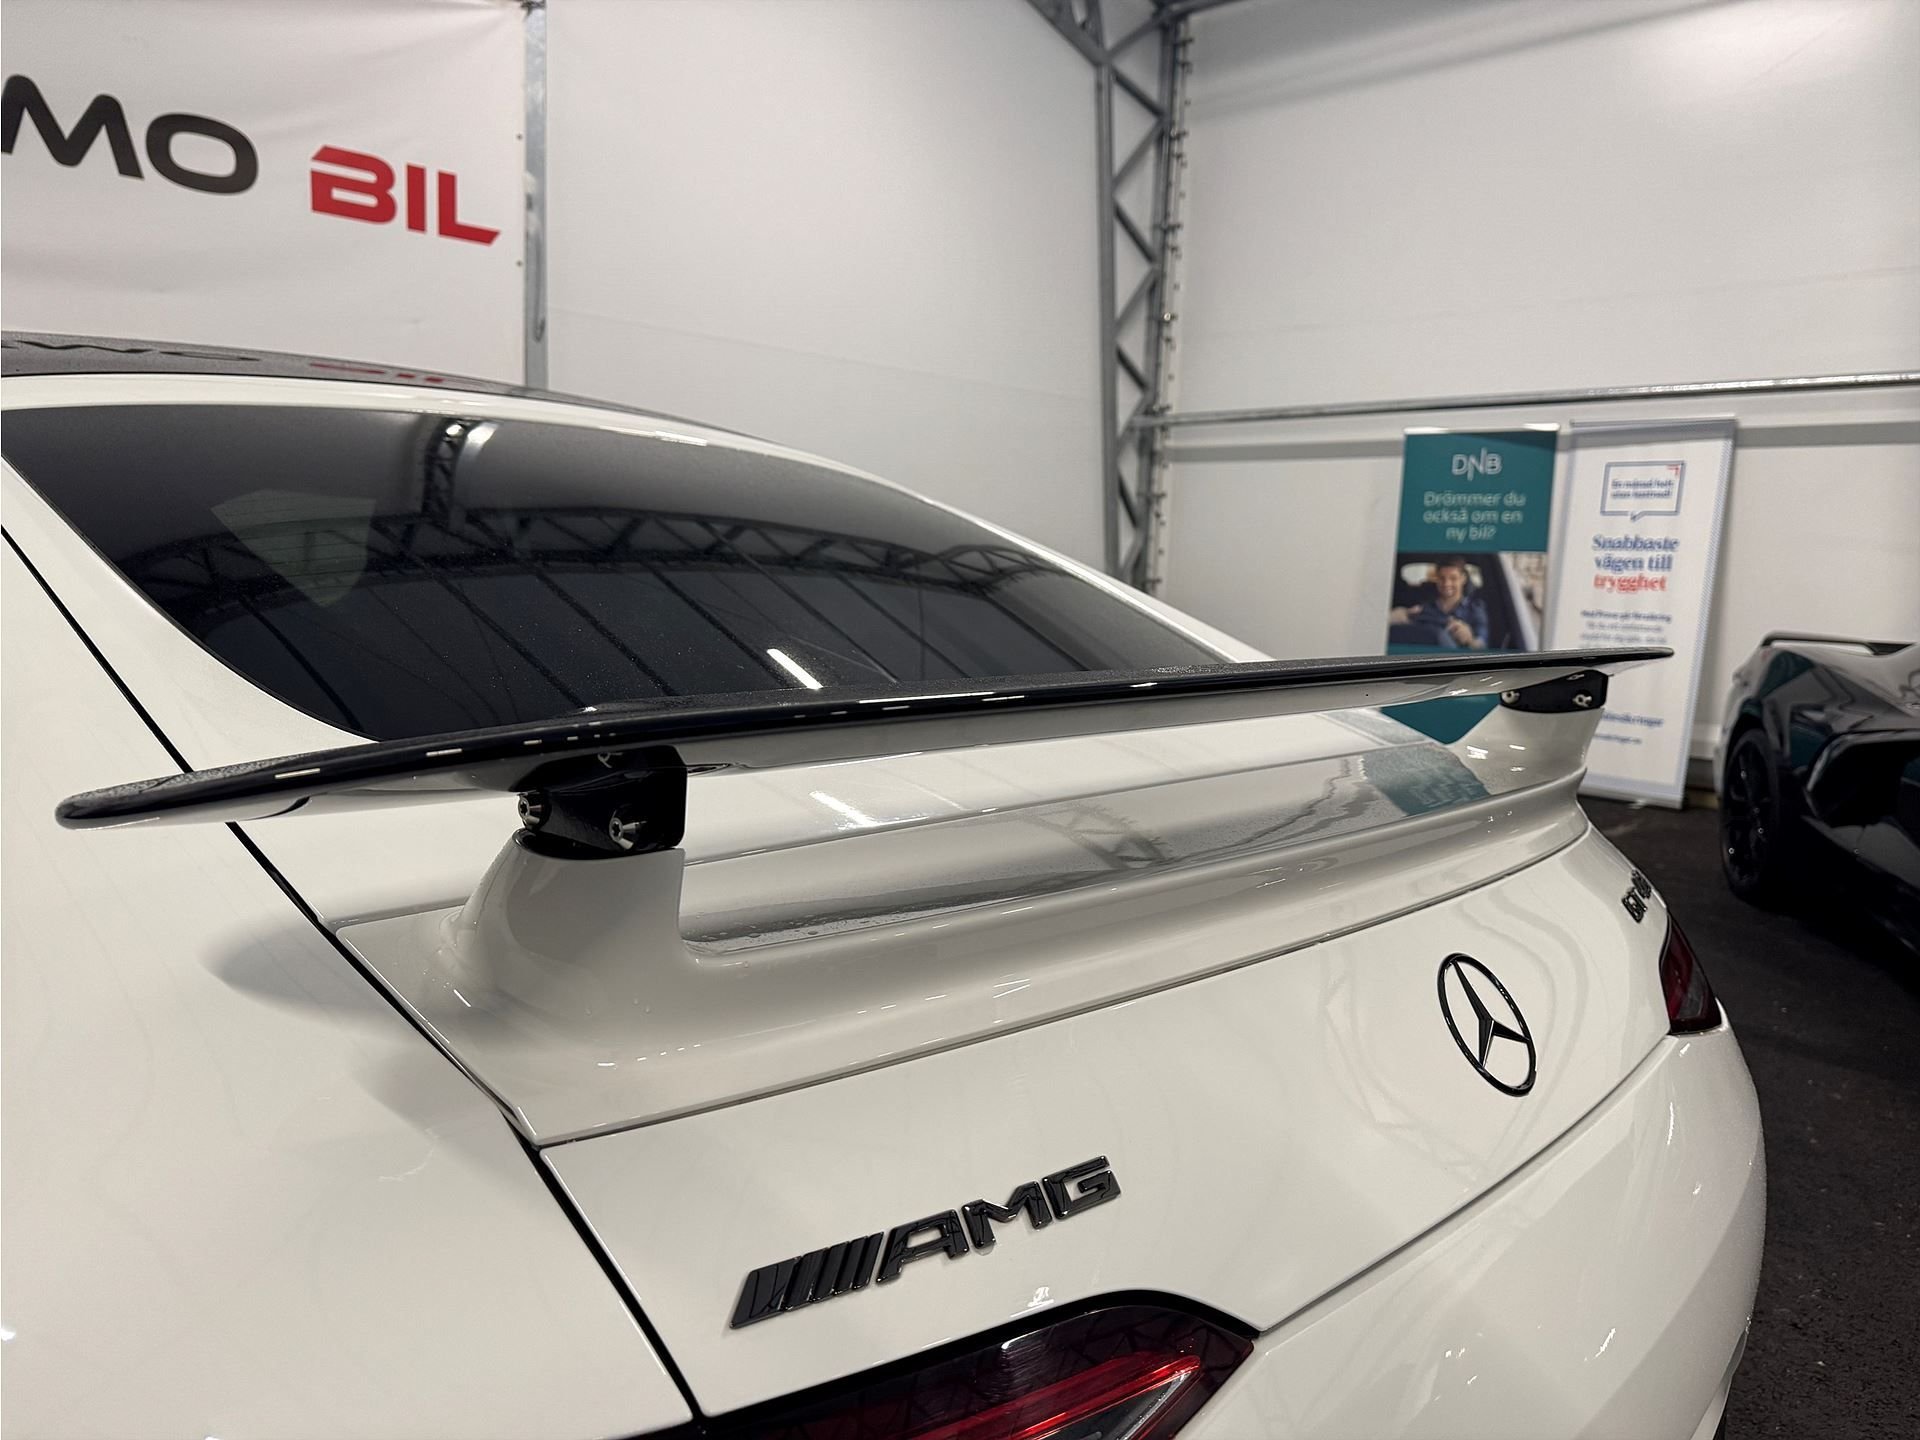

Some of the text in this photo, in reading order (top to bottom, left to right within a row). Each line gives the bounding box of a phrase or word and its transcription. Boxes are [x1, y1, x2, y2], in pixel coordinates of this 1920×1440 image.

[310, 145, 501, 246] BIL
[1451, 447, 1503, 481] DNB
[1423, 490, 1527, 507] Drömmer du
[1422, 508, 1524, 524] också om en
[1445, 524, 1497, 543] ny bil?
[1591, 534, 1680, 552] Snabbaste
[1594, 553, 1673, 574] vägen till
[1593, 573, 1668, 594] trygghet
[874, 1155, 1122, 1283] AMG
